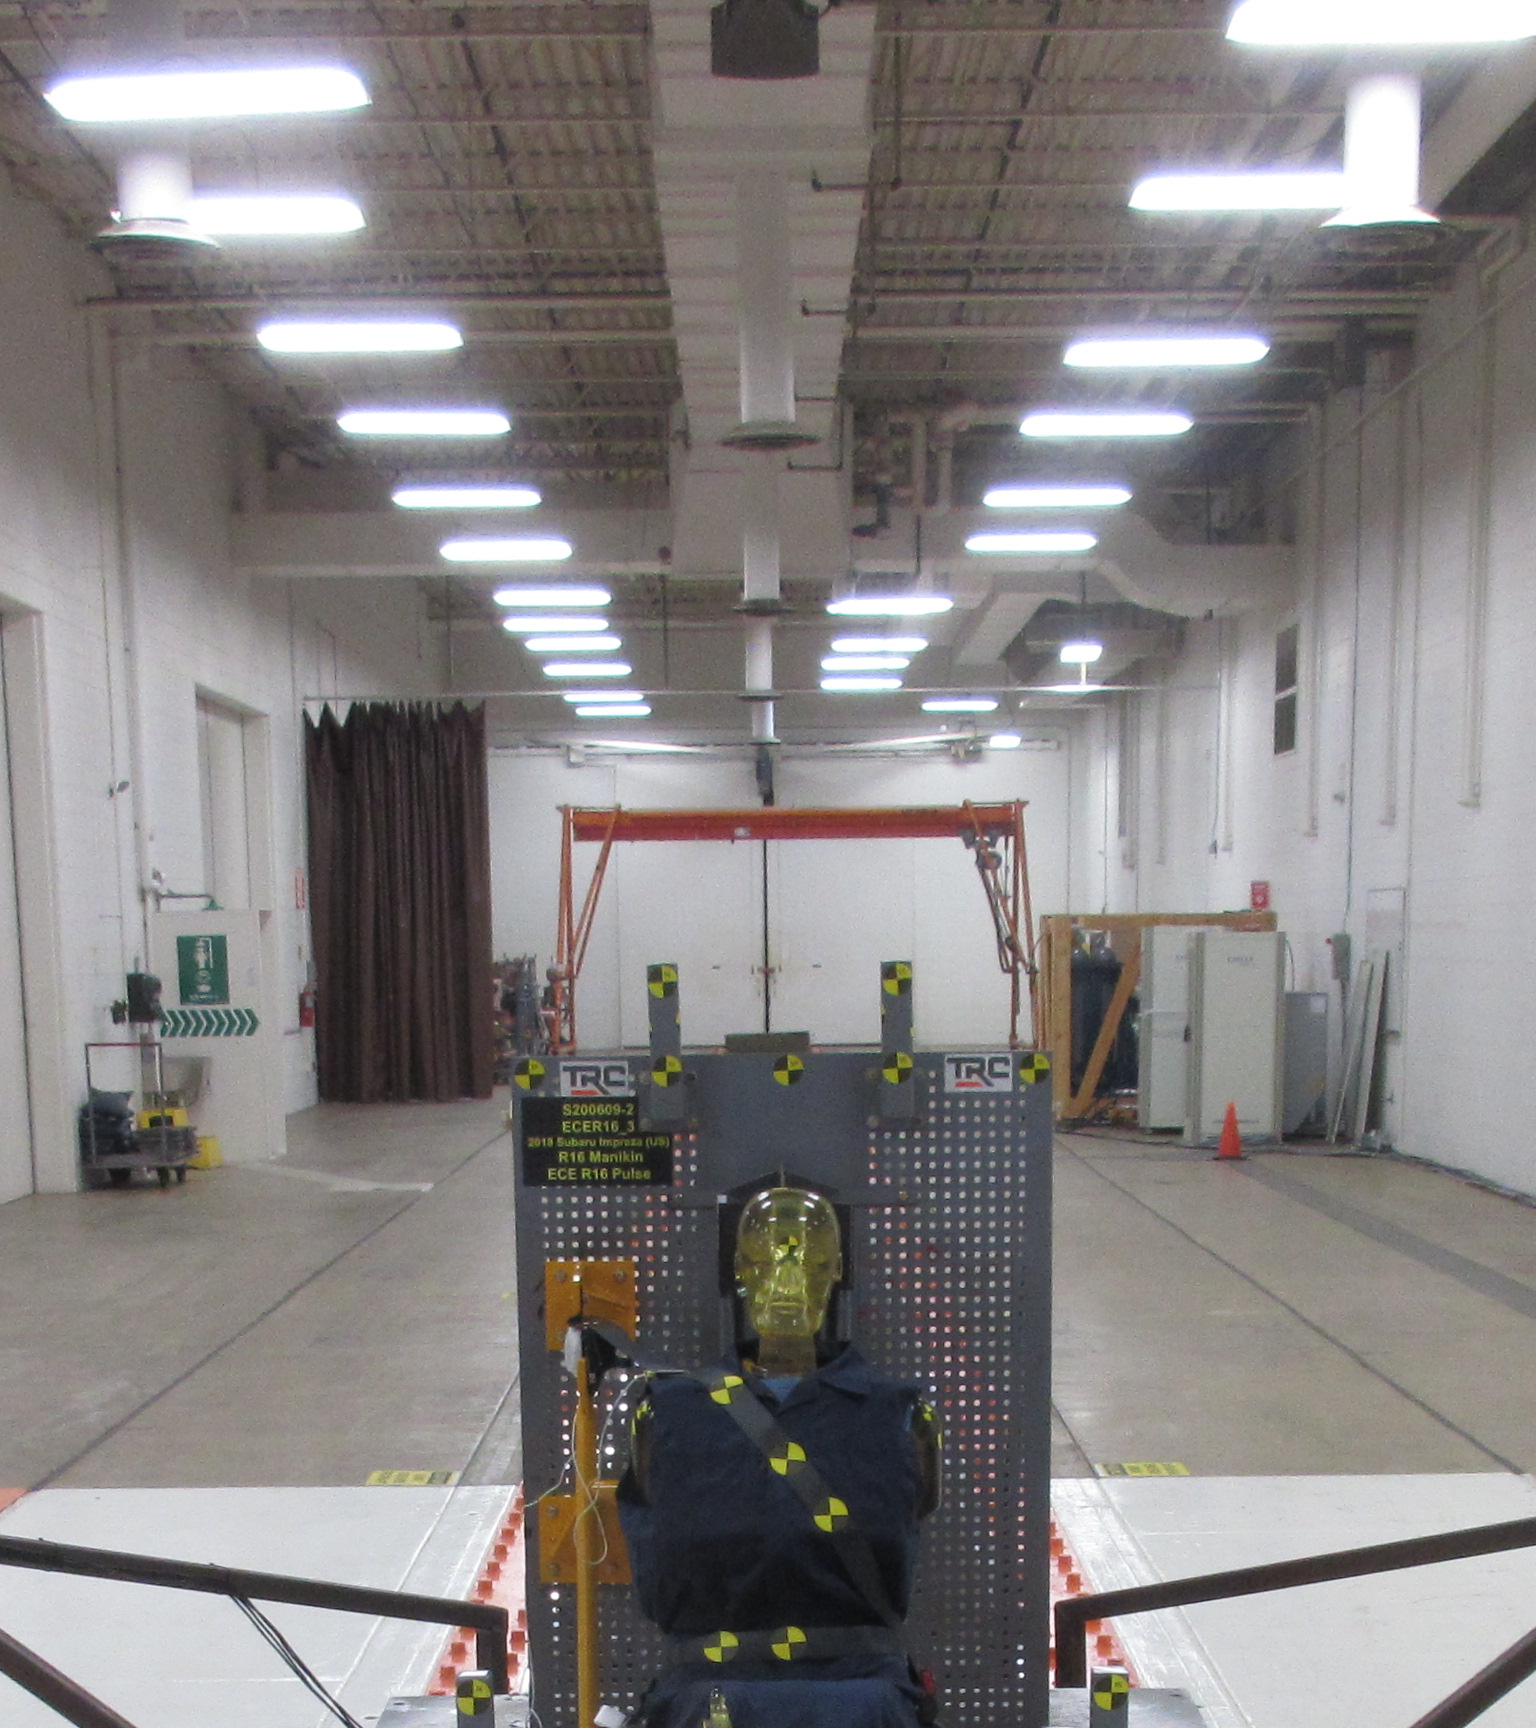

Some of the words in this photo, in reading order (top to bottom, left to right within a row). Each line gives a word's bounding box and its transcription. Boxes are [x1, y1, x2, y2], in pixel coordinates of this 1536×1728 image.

[946, 1056, 1010, 1088] TRC
[562, 1065, 627, 1096] TRC
[563, 1103, 635, 1117] S200609-2
[562, 1120, 635, 1136] ECER16_3
[557, 1138, 596, 1148] Subaru
[645, 1138, 670, 1149] (US)
[558, 1151, 585, 1163] R16
[589, 1151, 644, 1163] Manikin
[547, 1168, 578, 1180] ECE
[581, 1167, 608, 1180] R16
[612, 1167, 652, 1180] Pulse
